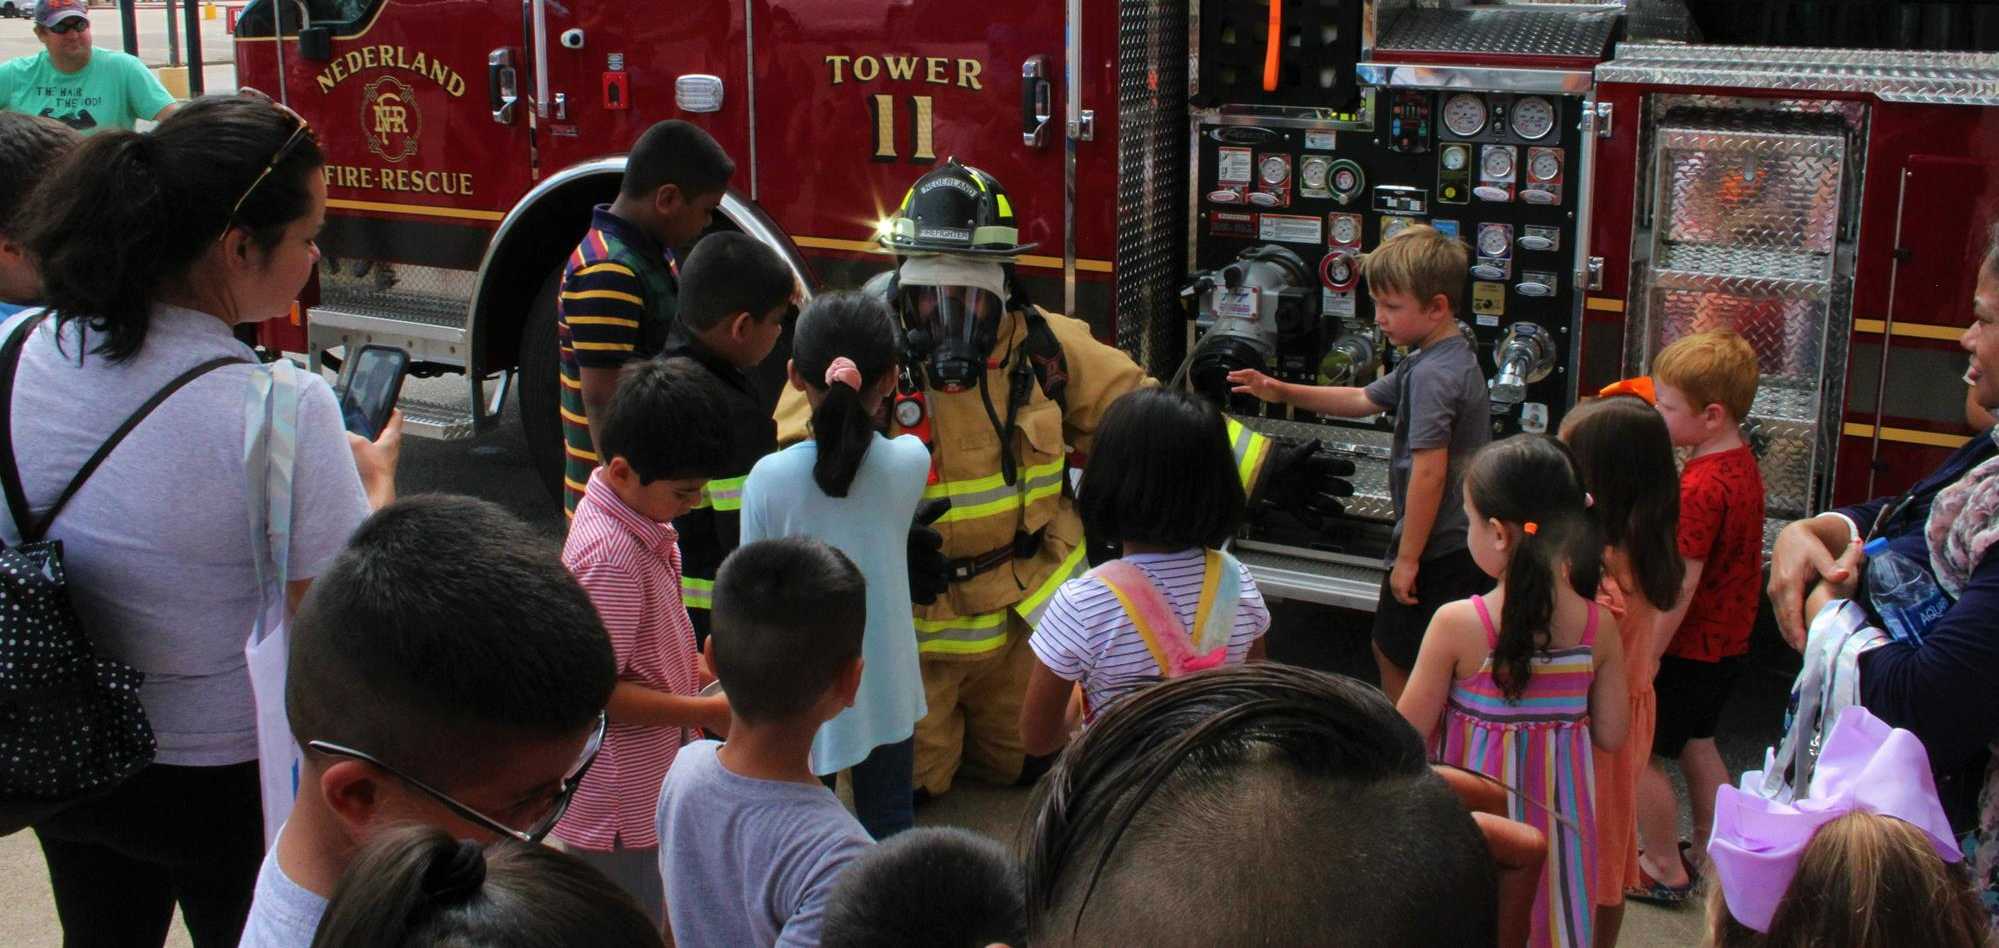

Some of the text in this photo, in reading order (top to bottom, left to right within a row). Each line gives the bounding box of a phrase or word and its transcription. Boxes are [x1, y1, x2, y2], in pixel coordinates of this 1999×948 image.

[316, 44, 466, 97] NEDERLAND
[825, 55, 983, 90] TOWER
[873, 94, 936, 161] 11
[920, 177, 978, 198] NEDERLAND
